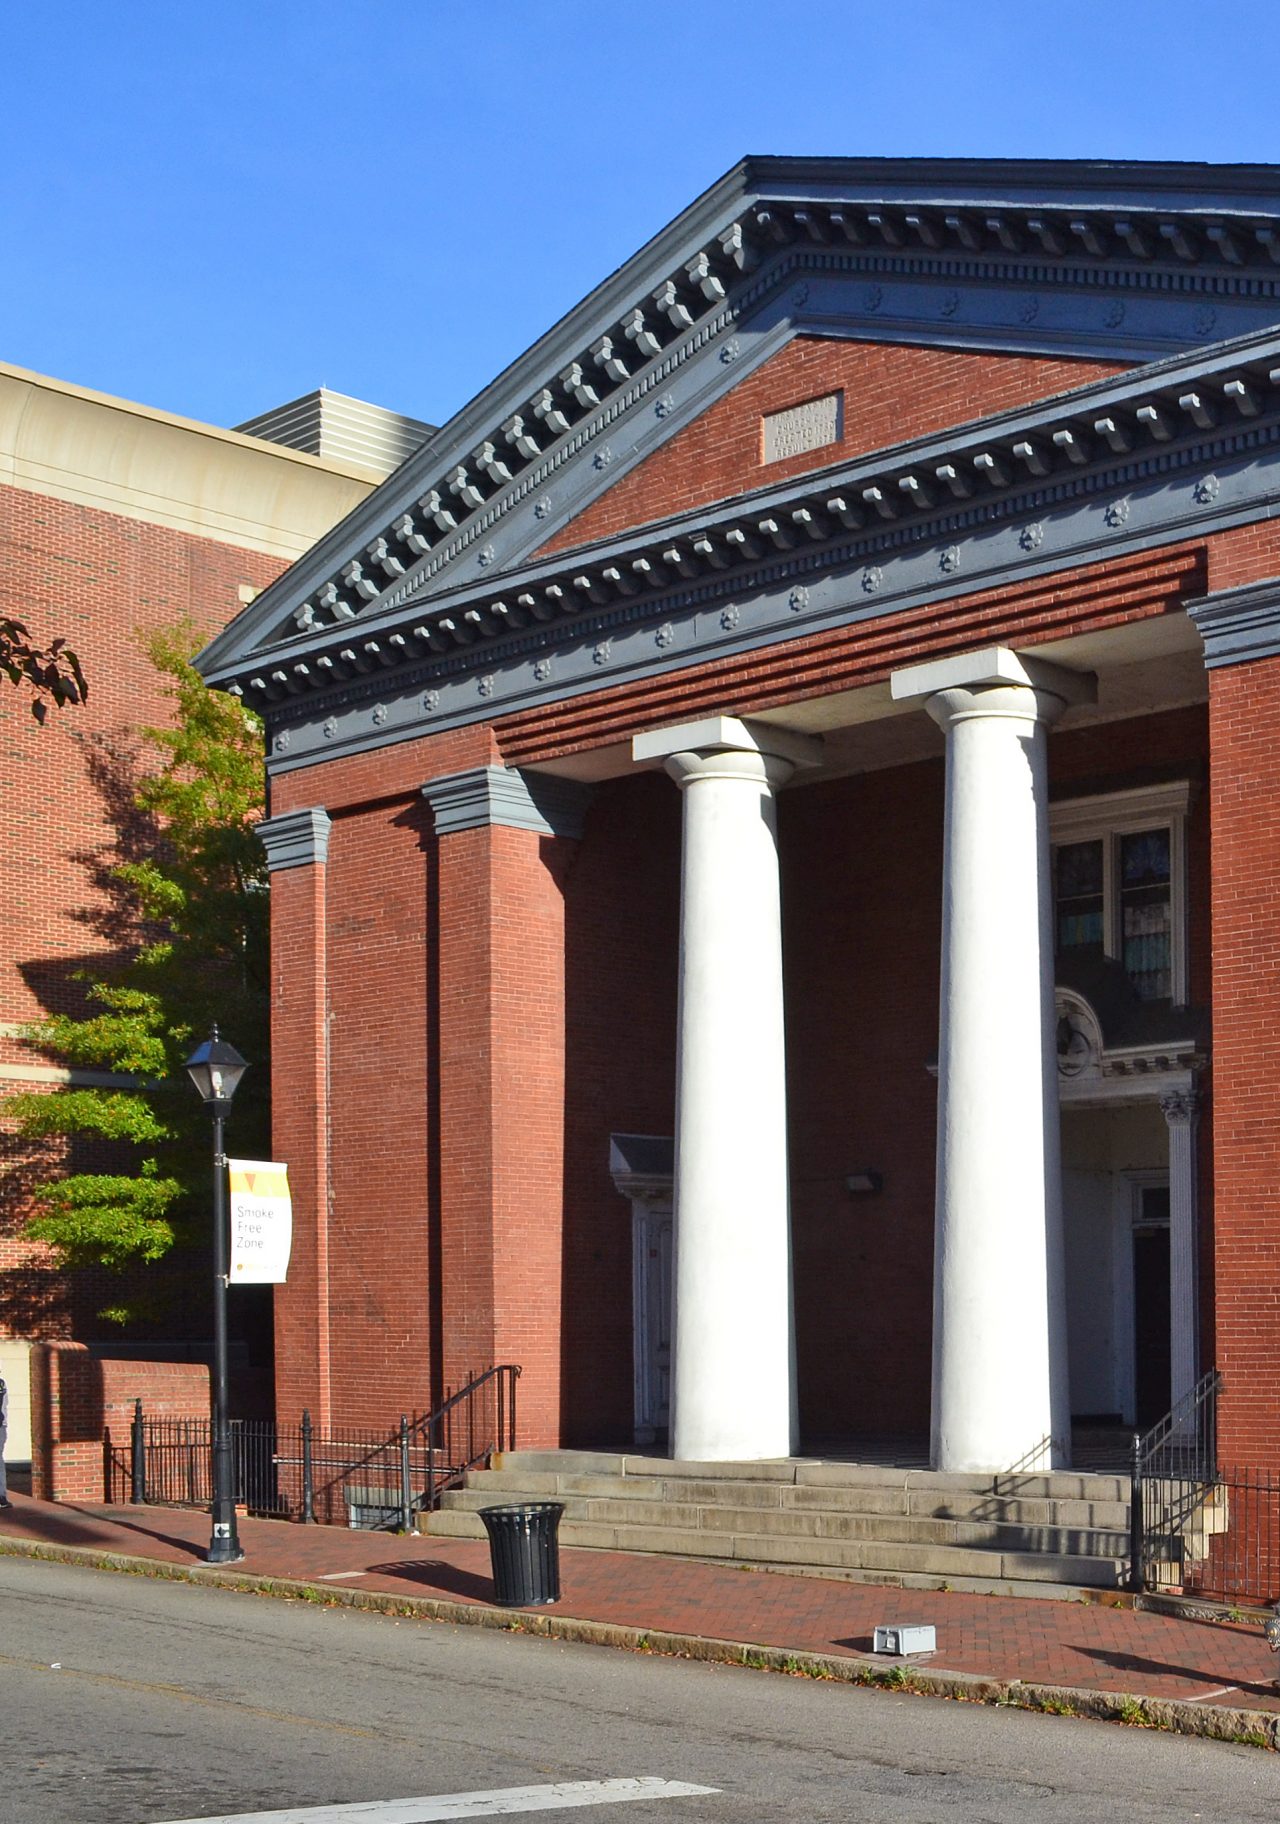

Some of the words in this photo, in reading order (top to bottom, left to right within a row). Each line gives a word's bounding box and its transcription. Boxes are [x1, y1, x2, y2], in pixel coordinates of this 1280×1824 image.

[773, 427, 813, 448] ERECTED
[776, 440, 812, 460] REBUILT
[237, 1205, 274, 1219] Smoke
[238, 1221, 262, 1233] Free
[236, 1236, 264, 1249] Zone
